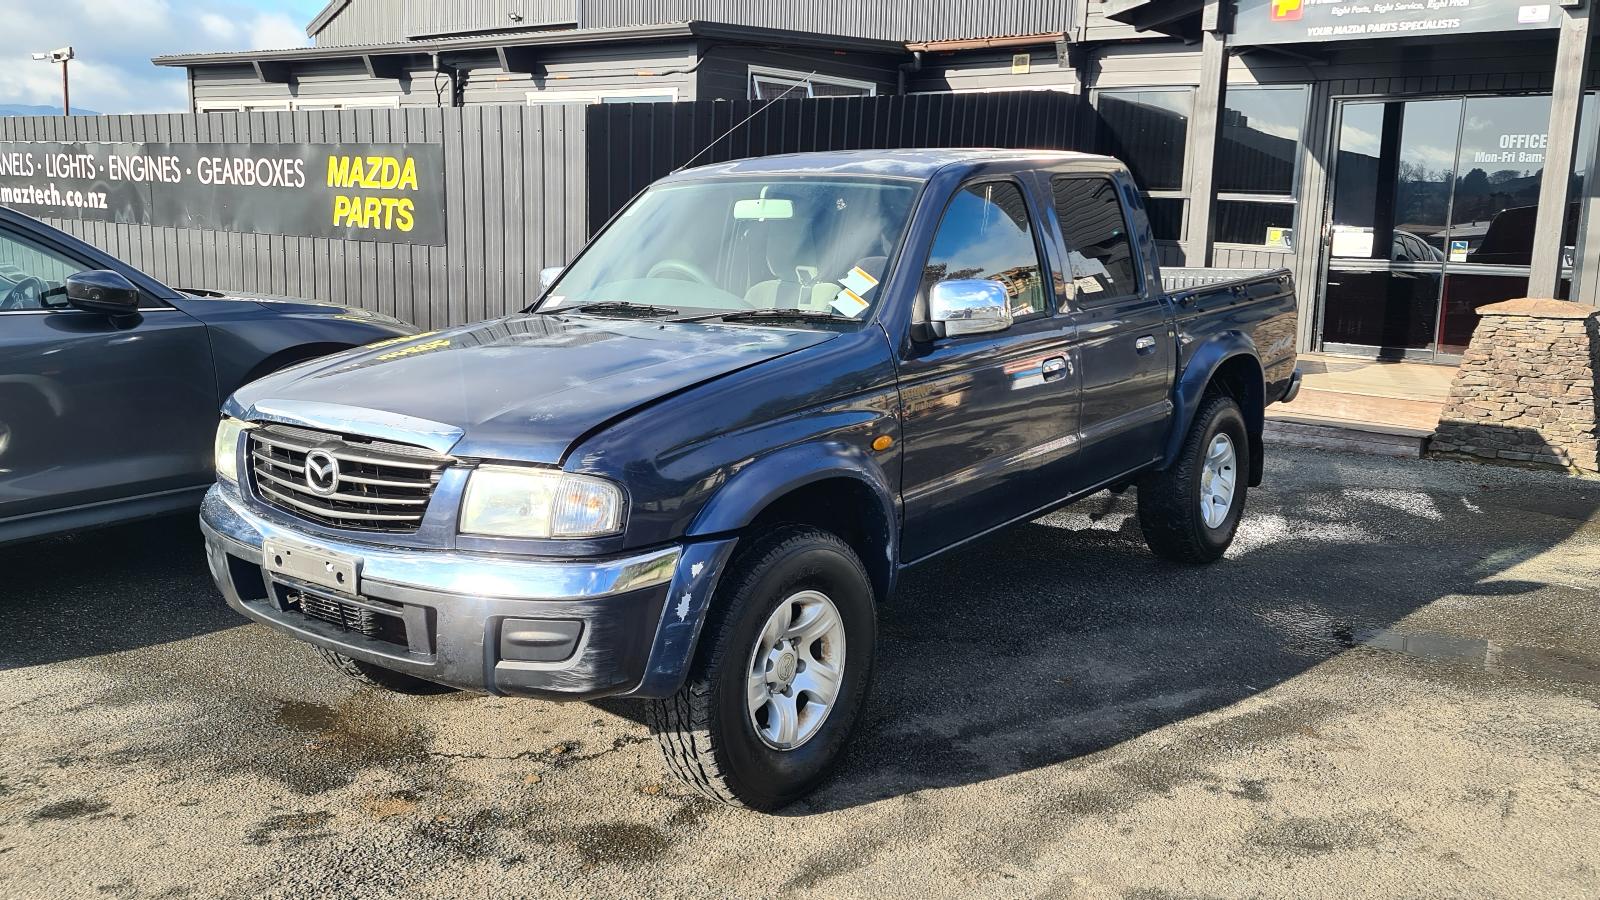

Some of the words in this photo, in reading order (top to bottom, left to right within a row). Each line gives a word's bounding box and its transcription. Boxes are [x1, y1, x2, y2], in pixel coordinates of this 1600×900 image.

[1307, 26, 1333, 36] YOUR
[1333, 24, 1366, 35] MAZDA
[1367, 22, 1398, 33] PARTS
[1398, 18, 1460, 31] SPECIALISTS
[1499, 134, 1548, 149] OFFICE
[0, 152, 35, 177] NELS
[45, 153, 96, 180] LIGHTS
[109, 155, 181, 183] ENGINES
[198, 156, 306, 188] GEARBOXES
[1474, 151, 1516, 163] Mon-Fri
[327, 155, 419, 190] MAZDA
[333, 196, 415, 232] PARTS
